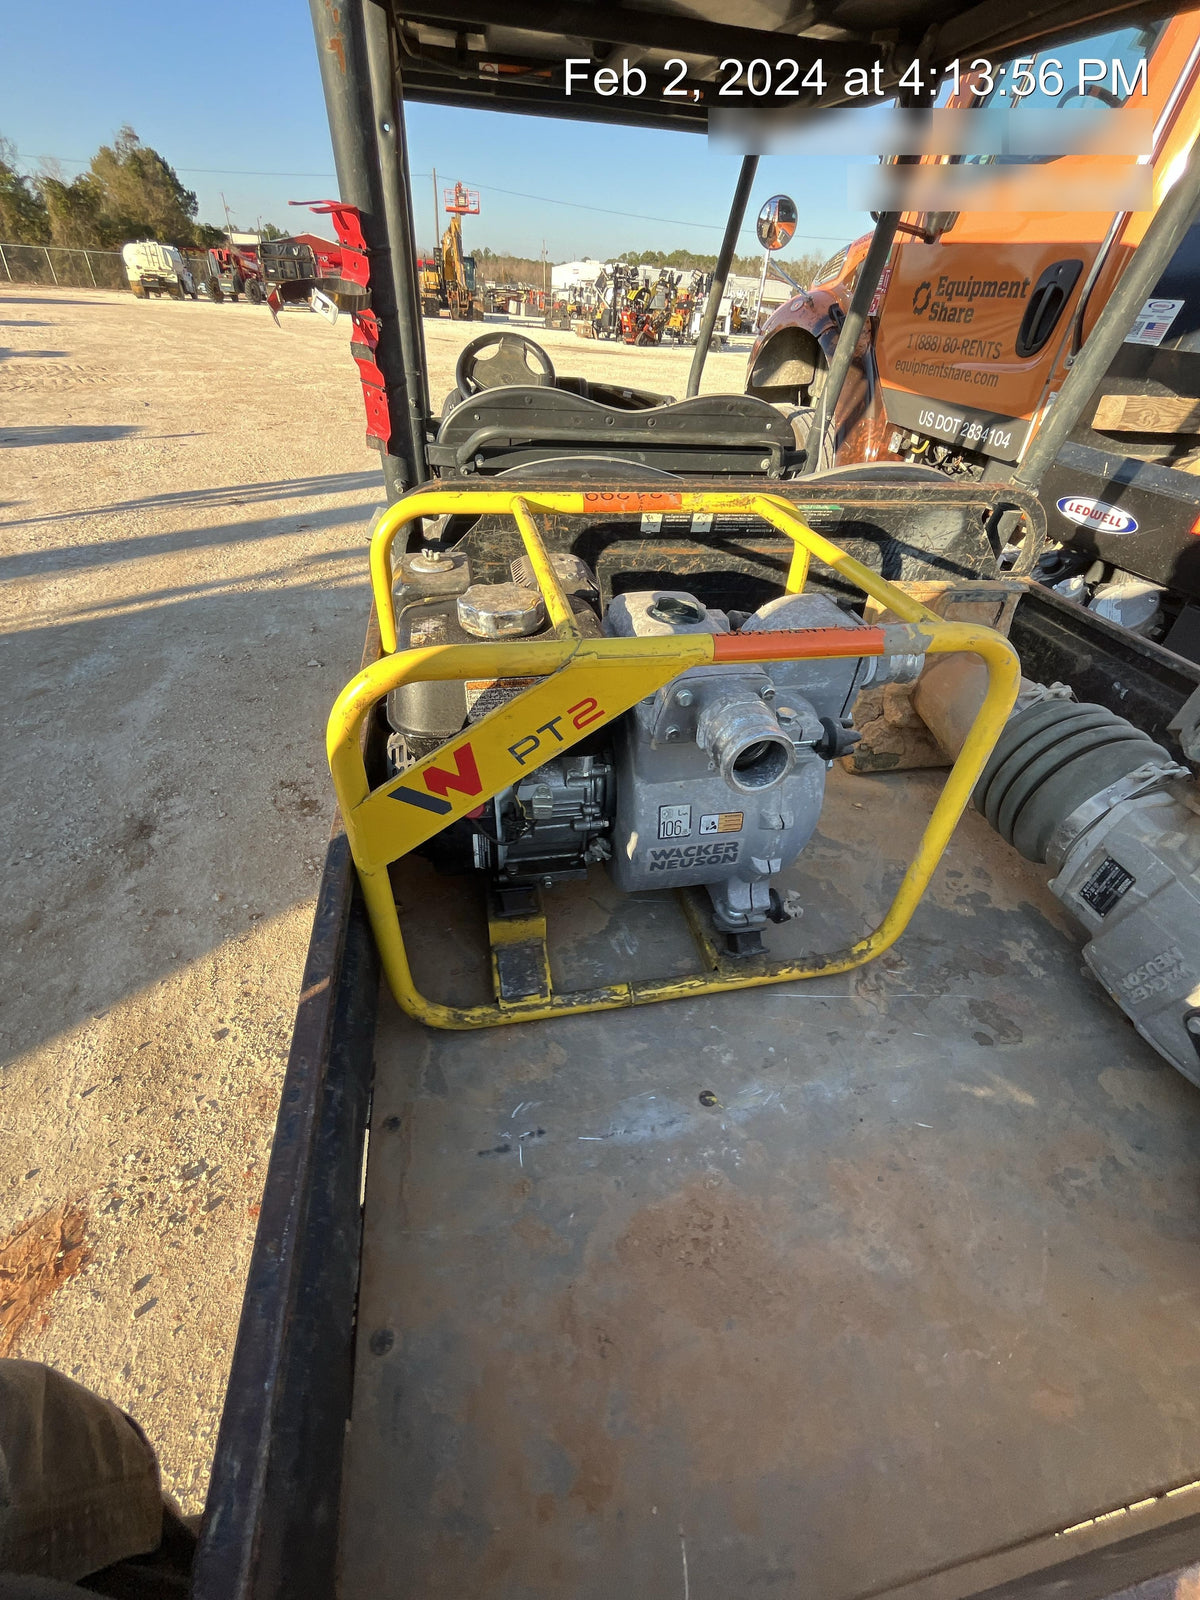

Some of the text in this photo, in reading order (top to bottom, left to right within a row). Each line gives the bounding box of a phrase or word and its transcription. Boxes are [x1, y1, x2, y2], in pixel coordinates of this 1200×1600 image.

[935, 275, 1031, 302] Equipment
[928, 302, 975, 324] Share
[907, 333, 1003, 359] 1 (888) 80-RENTS
[895, 358, 999, 388] equipmentshare.com
[918, 409, 1012, 449] US DOT 2834104
[1068, 502, 1122, 528] LEDWELL
[507, 697, 606, 766] PT2
[661, 819, 683, 837] 106
[649, 852, 738, 872] NEUSON
[650, 841, 740, 861] WACKER
